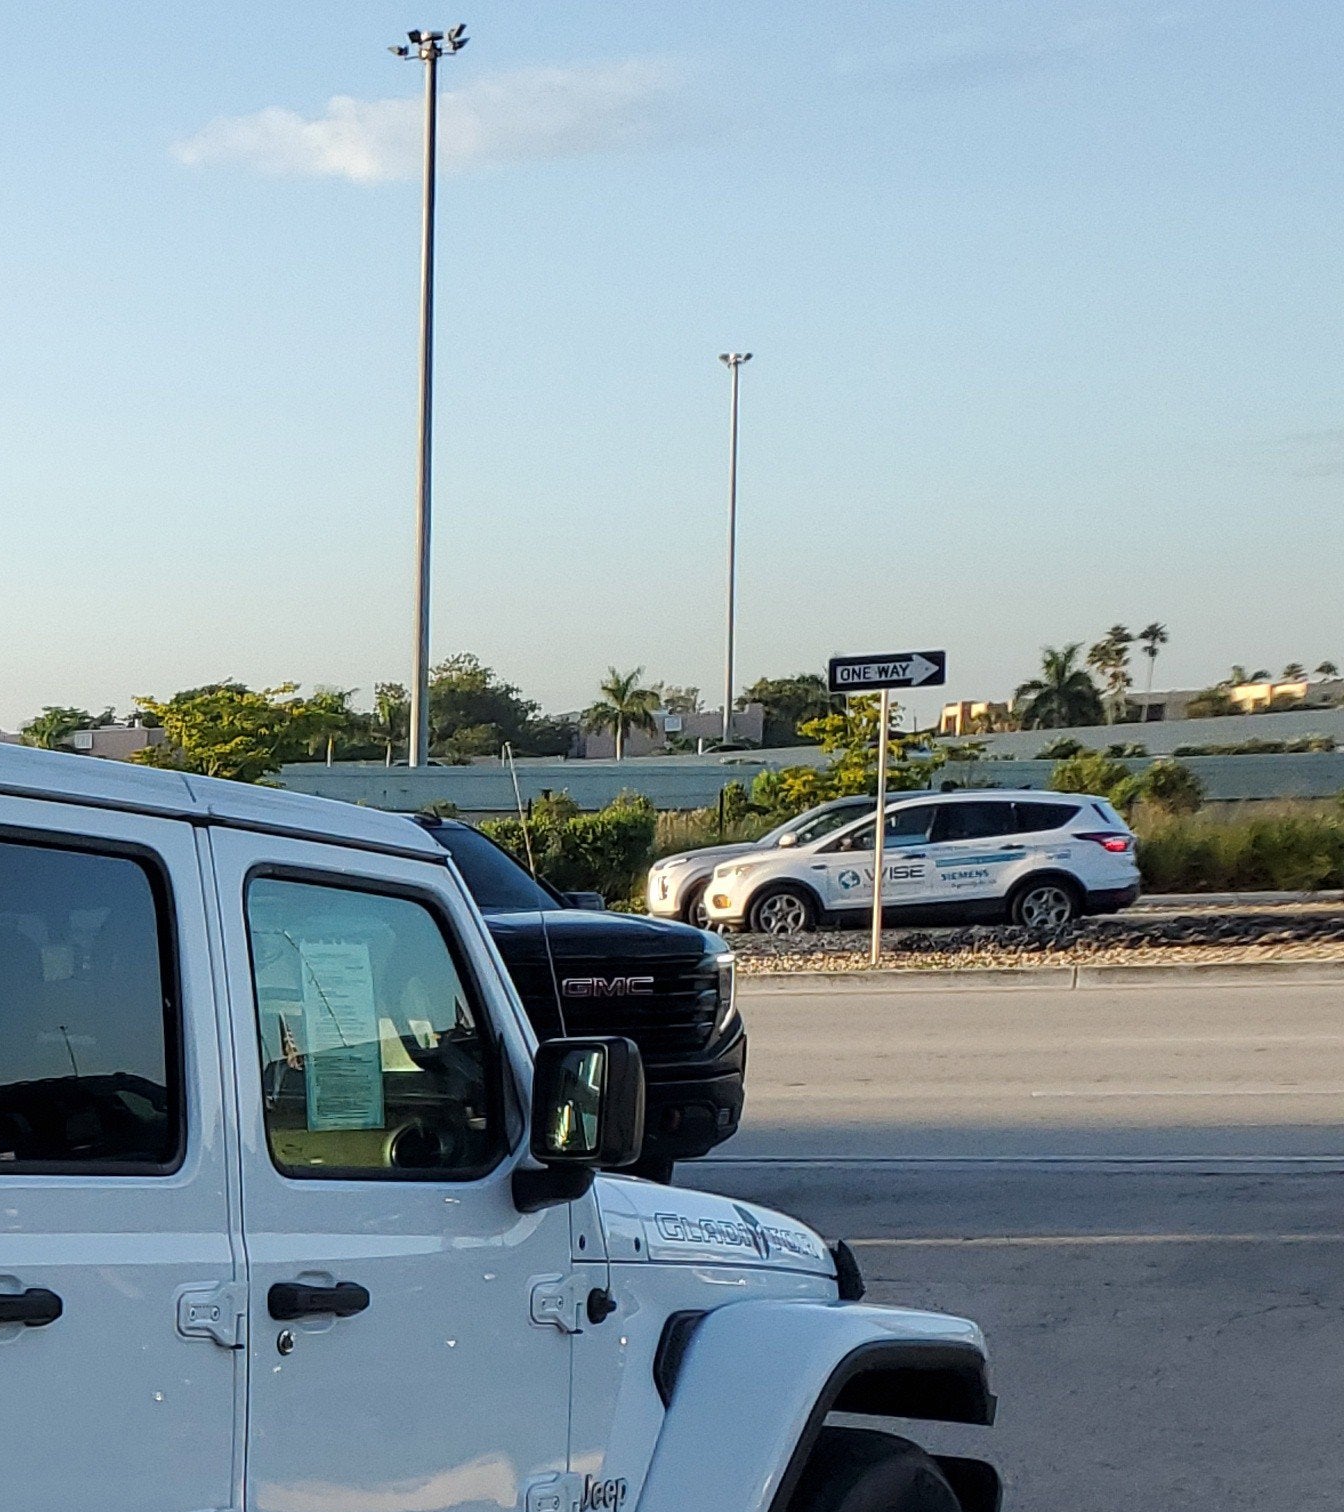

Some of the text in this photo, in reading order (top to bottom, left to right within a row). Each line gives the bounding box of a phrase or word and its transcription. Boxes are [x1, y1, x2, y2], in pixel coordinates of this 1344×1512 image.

[840, 663, 910, 682] ONE WAY
[864, 864, 926, 882] WISE
[940, 869, 989, 881] SIEMENS
[561, 976, 654, 997] GMC
[654, 1211, 824, 1261] GLADITOR
